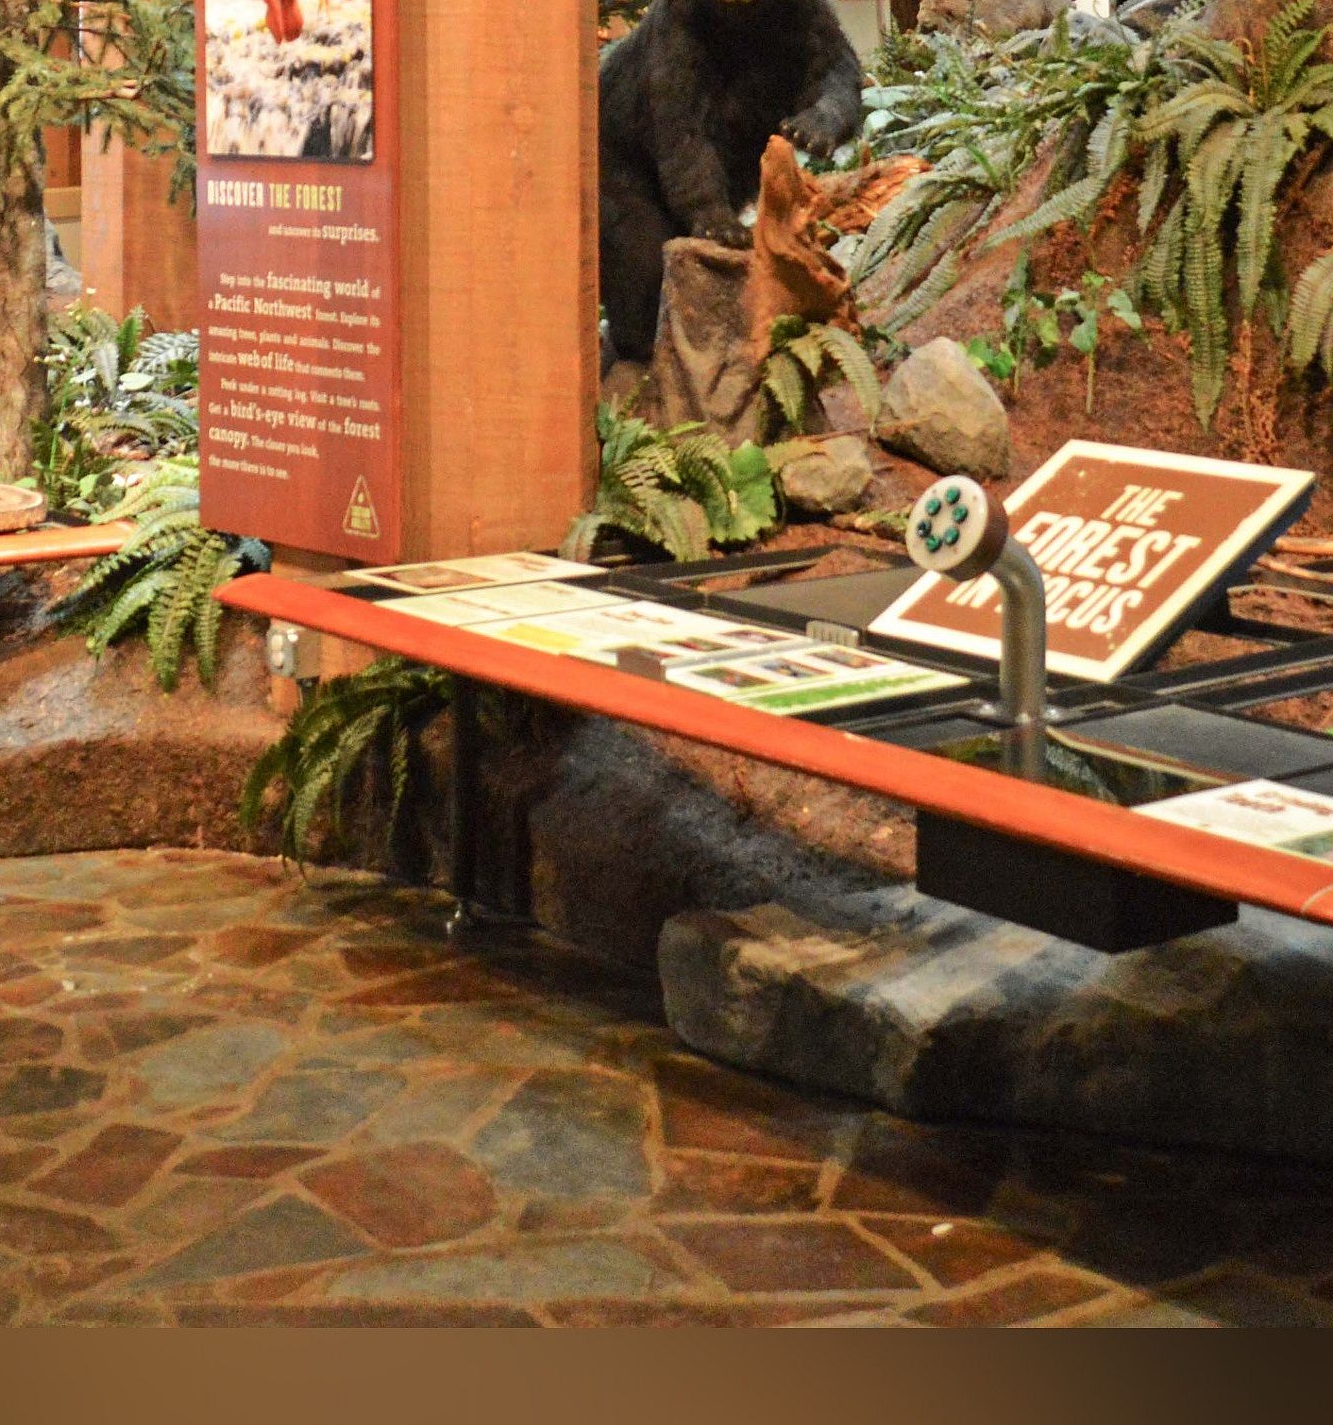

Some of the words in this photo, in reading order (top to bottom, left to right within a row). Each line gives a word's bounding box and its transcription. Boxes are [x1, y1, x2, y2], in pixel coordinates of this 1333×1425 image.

[207, 180, 264, 207] DISCOVER
[269, 183, 290, 208] THE
[295, 184, 343, 211] FOREST
[322, 223, 380, 245] surprises.
[267, 271, 332, 300] fascinating
[334, 279, 369, 298] world
[215, 293, 251, 313] Pacific
[253, 296, 312, 319] Northwest
[238, 349, 260, 369] web
[261, 351, 273, 369] of
[274, 352, 294, 372] life
[230, 399, 285, 429] bird's-eye
[287, 409, 317, 429] view
[344, 416, 380, 440] forest
[208, 426, 249, 450] canopy.
[1100, 484, 1185, 526] THE
[1014, 511, 1202, 588] FOREST
[995, 573, 1143, 634] OCUS
